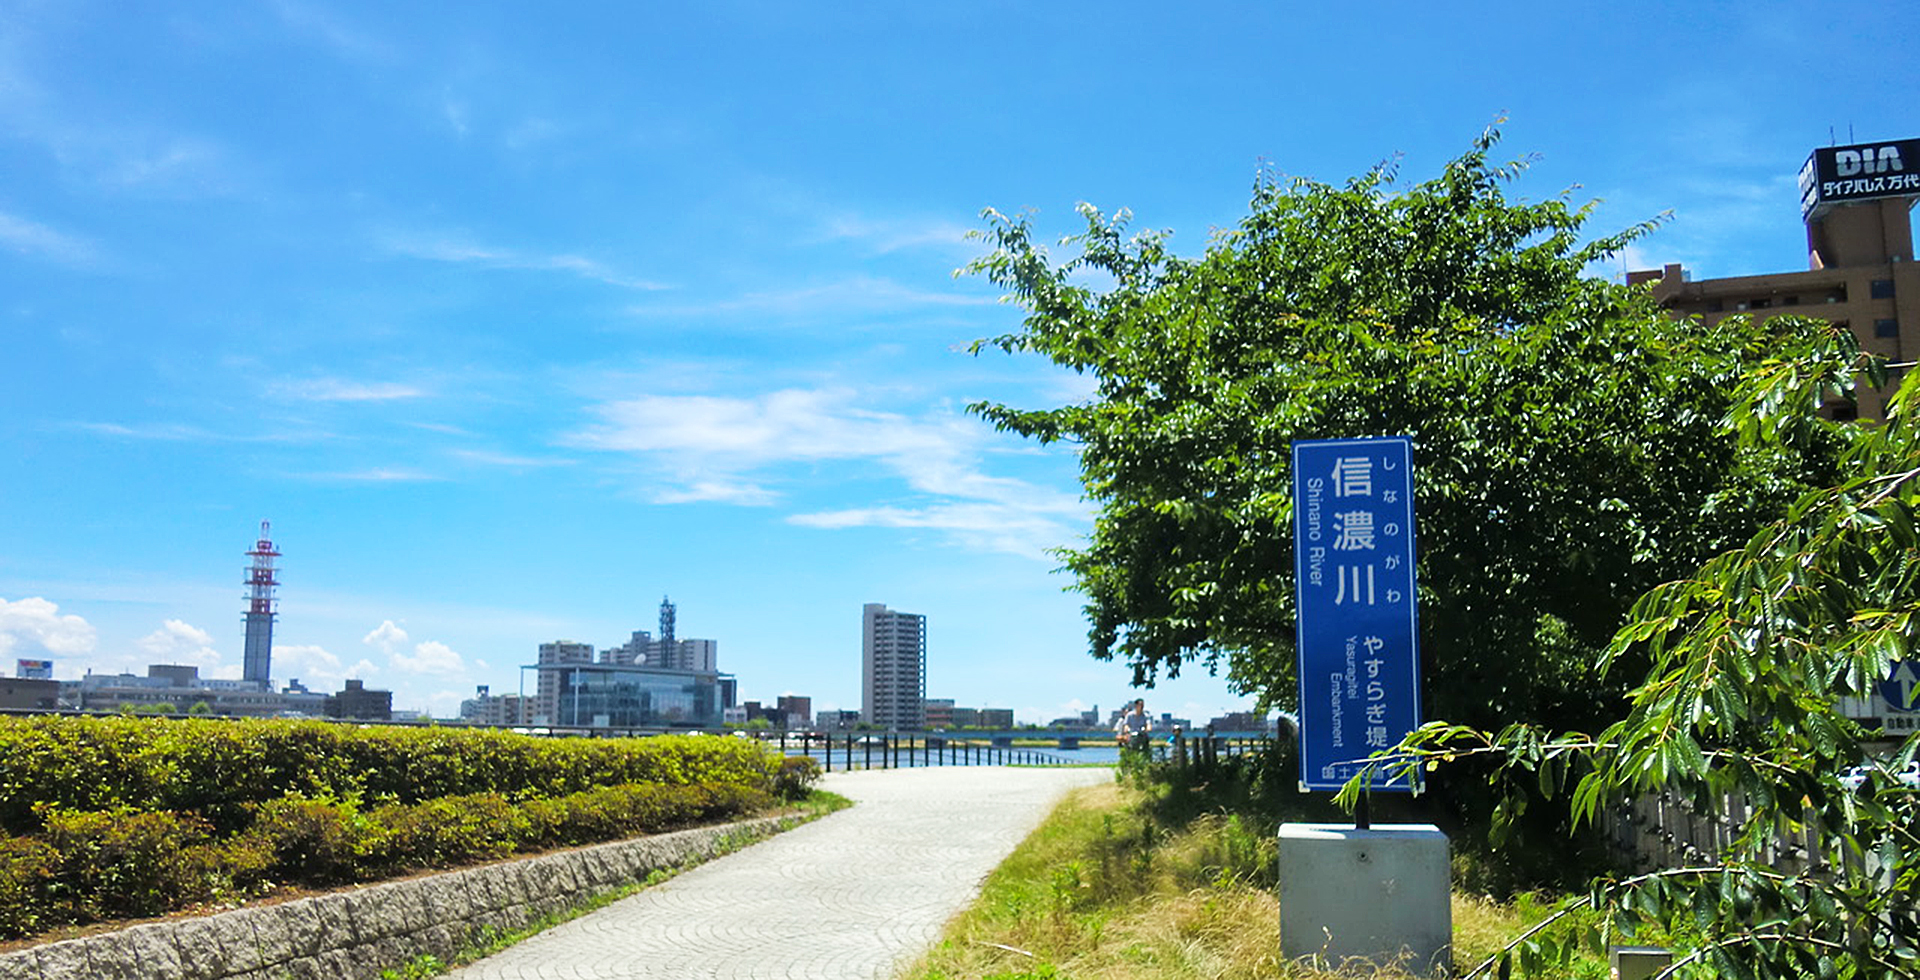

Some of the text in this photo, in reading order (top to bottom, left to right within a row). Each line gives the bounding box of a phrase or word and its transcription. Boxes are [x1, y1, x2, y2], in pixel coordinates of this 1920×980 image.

[1835, 146, 1904, 177] DIA
[1307, 477, 1326, 587] Shinano River
[1331, 457, 1375, 606] 信濃川
[1383, 456, 1401, 603] しなのがわ
[1330, 672, 1344, 748] Embankment
[1345, 635, 1360, 700] Yasuragitei
[1363, 635, 1388, 747] やすらぎ堤
